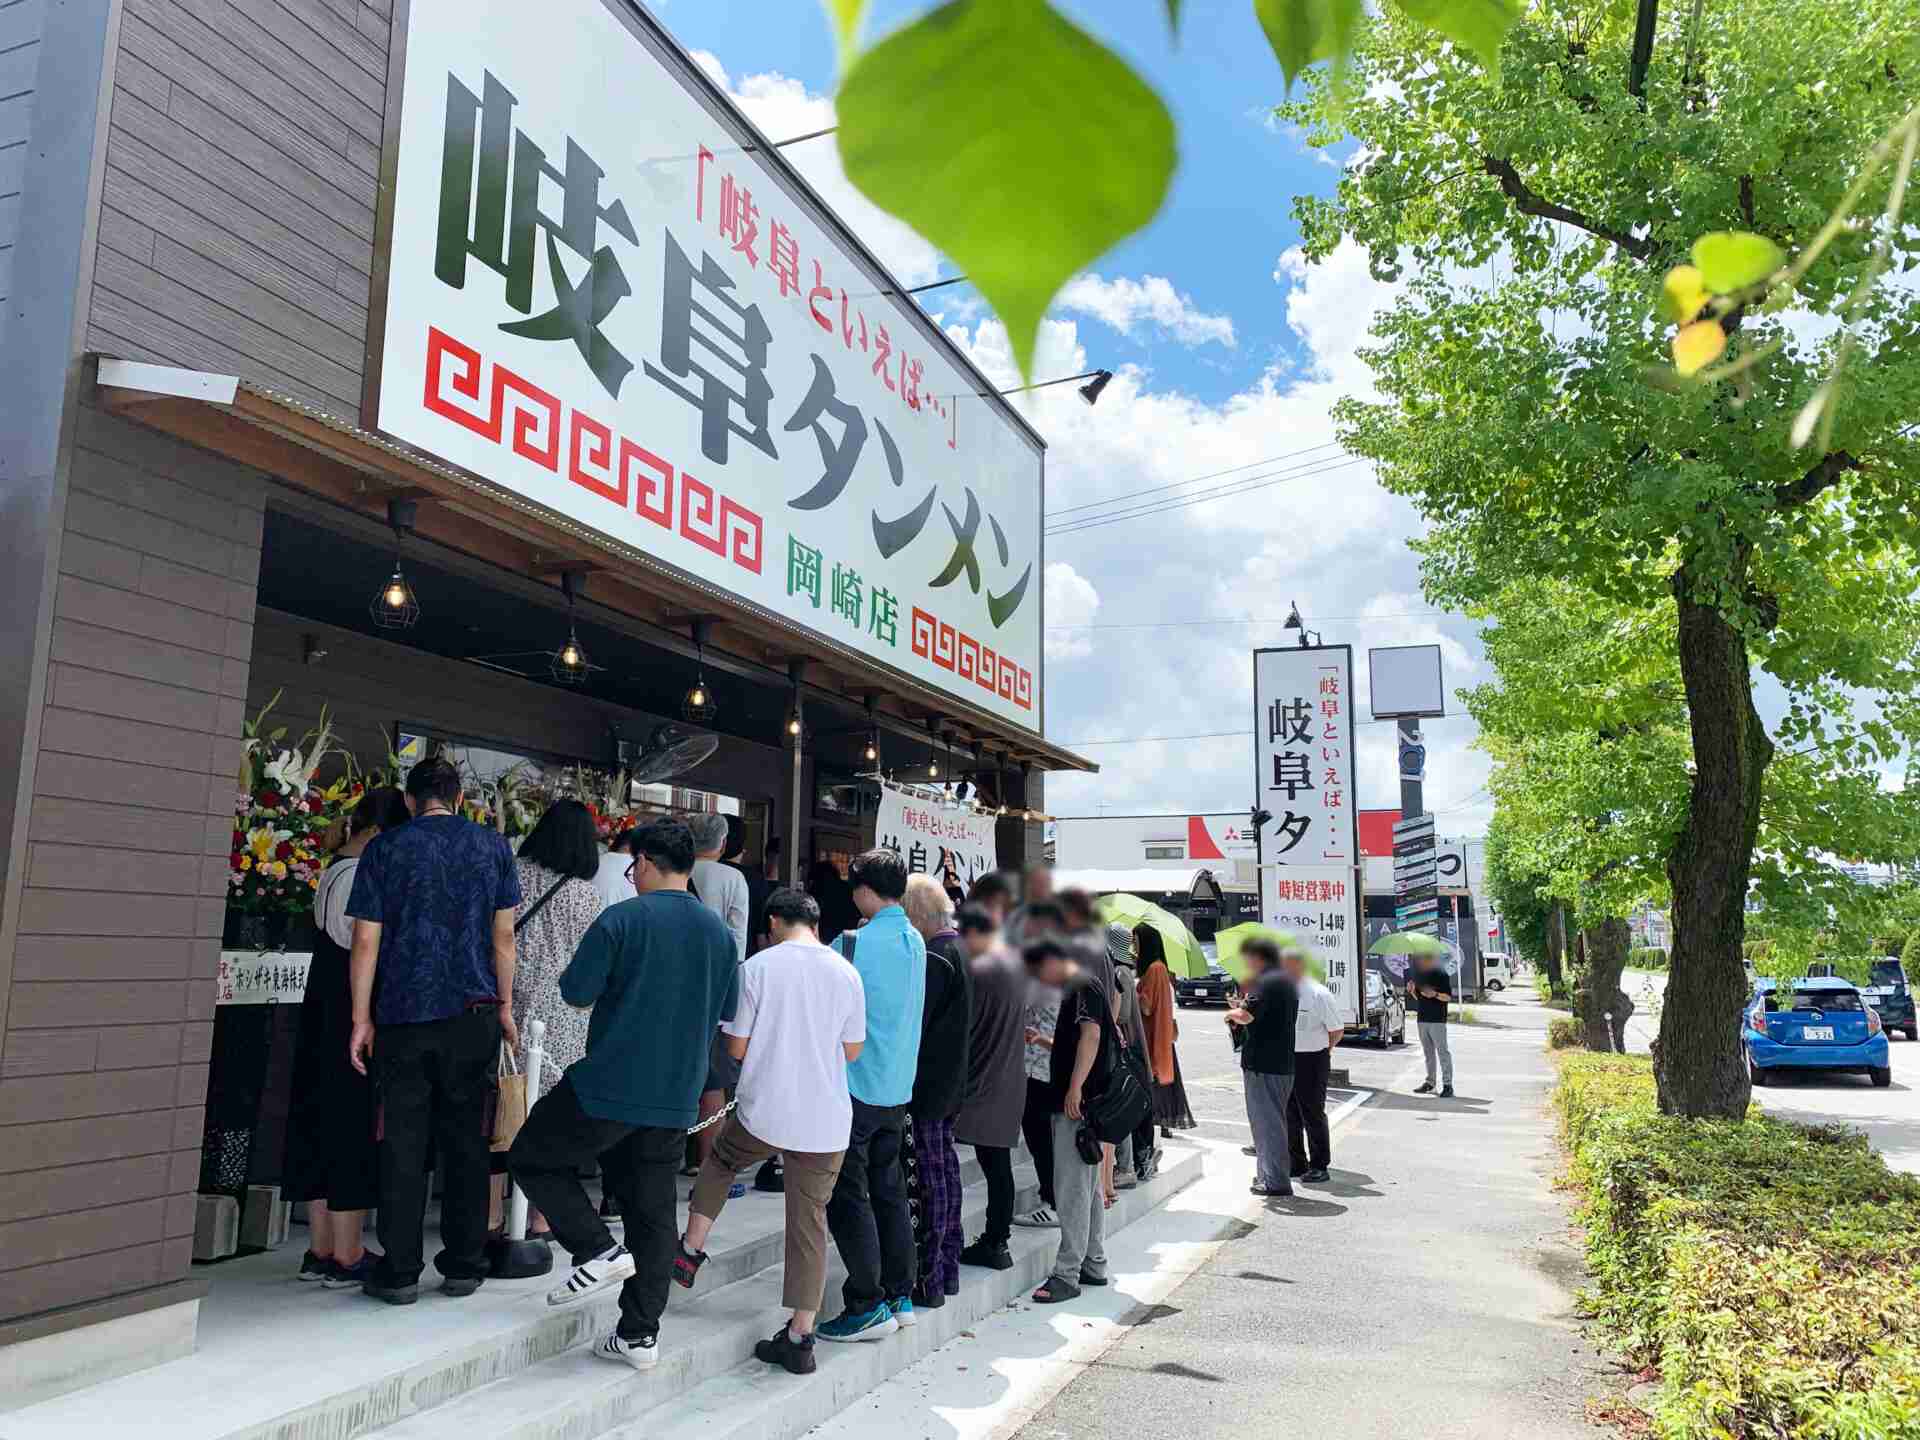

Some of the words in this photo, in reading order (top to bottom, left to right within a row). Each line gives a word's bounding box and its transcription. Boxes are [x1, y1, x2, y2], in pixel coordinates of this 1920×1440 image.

[434, 68, 1032, 629] 岐阜タンメン
[786, 532, 900, 647] 岡崎店
[1268, 697, 1315, 865] 岐阜タ
[1279, 880, 1345, 902] 時短営業中
